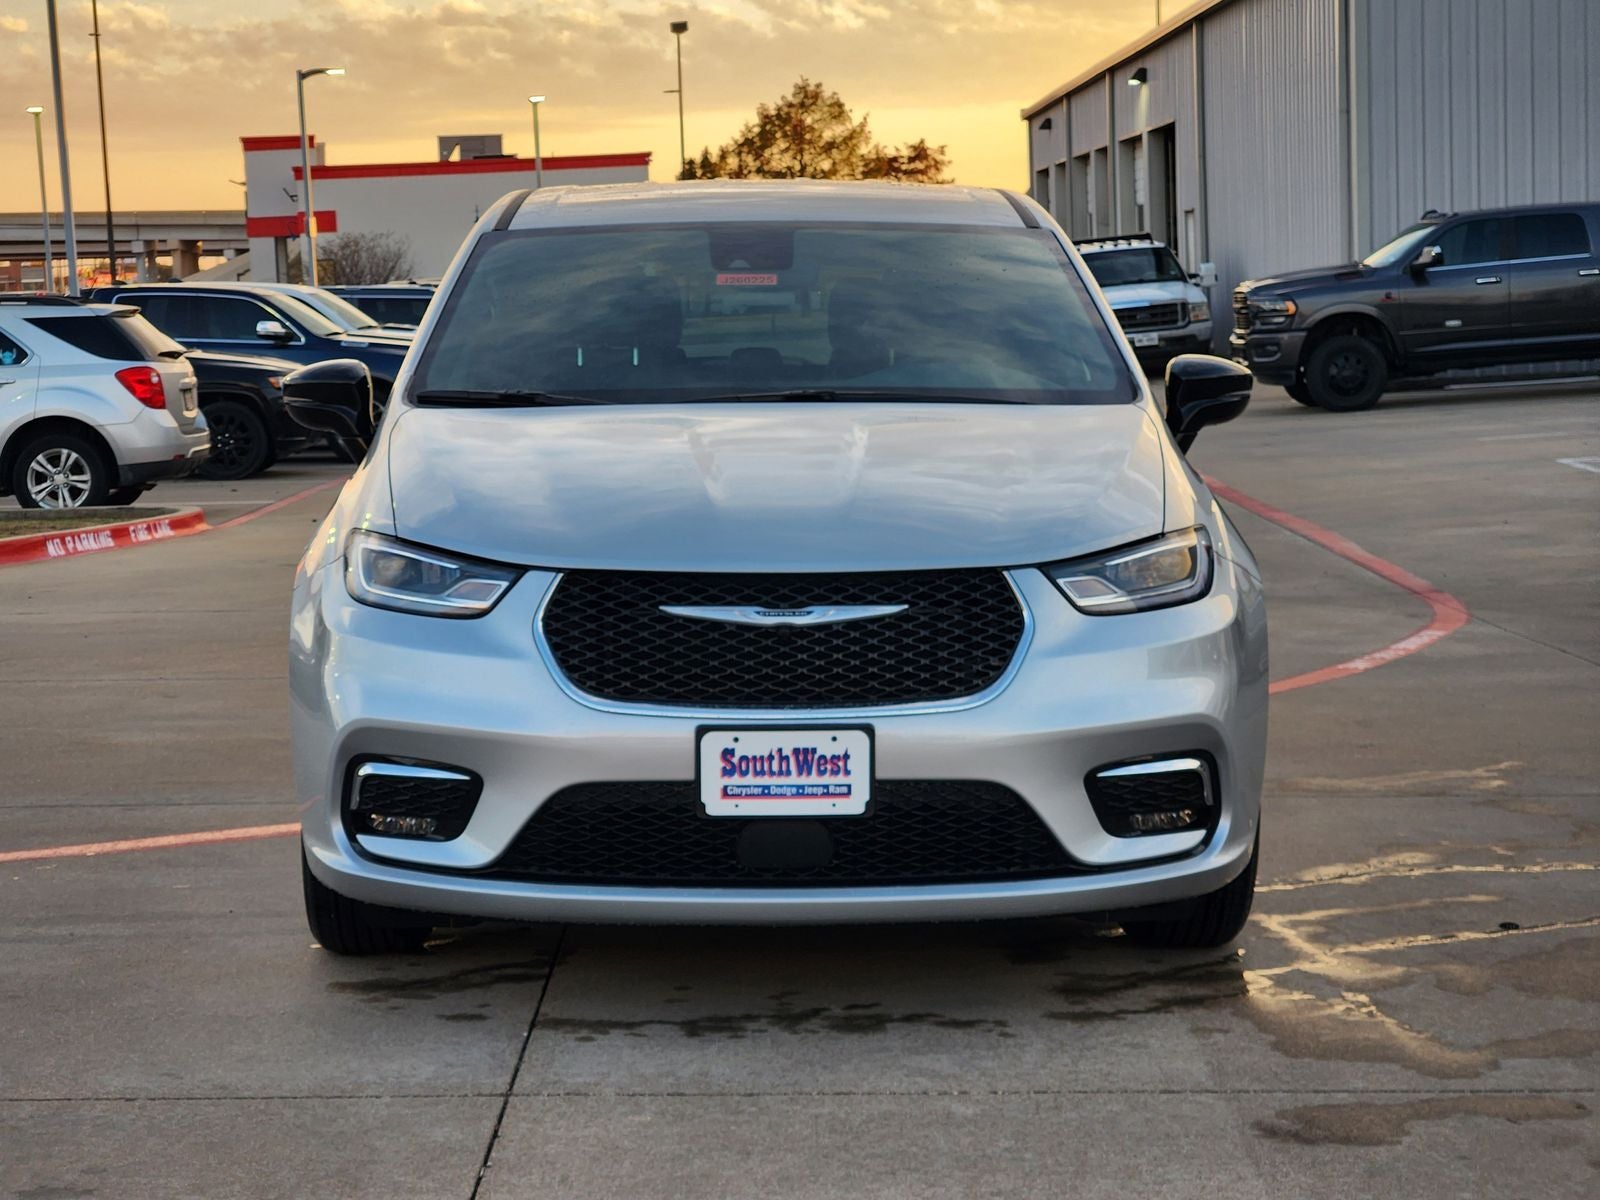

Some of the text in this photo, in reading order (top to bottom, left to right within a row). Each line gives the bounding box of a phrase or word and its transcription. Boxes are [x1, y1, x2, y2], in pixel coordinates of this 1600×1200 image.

[46, 540, 65, 557] NO
[66, 530, 115, 553] PARKING
[727, 785, 848, 796] Chrysler Dodge Jeep Ram
